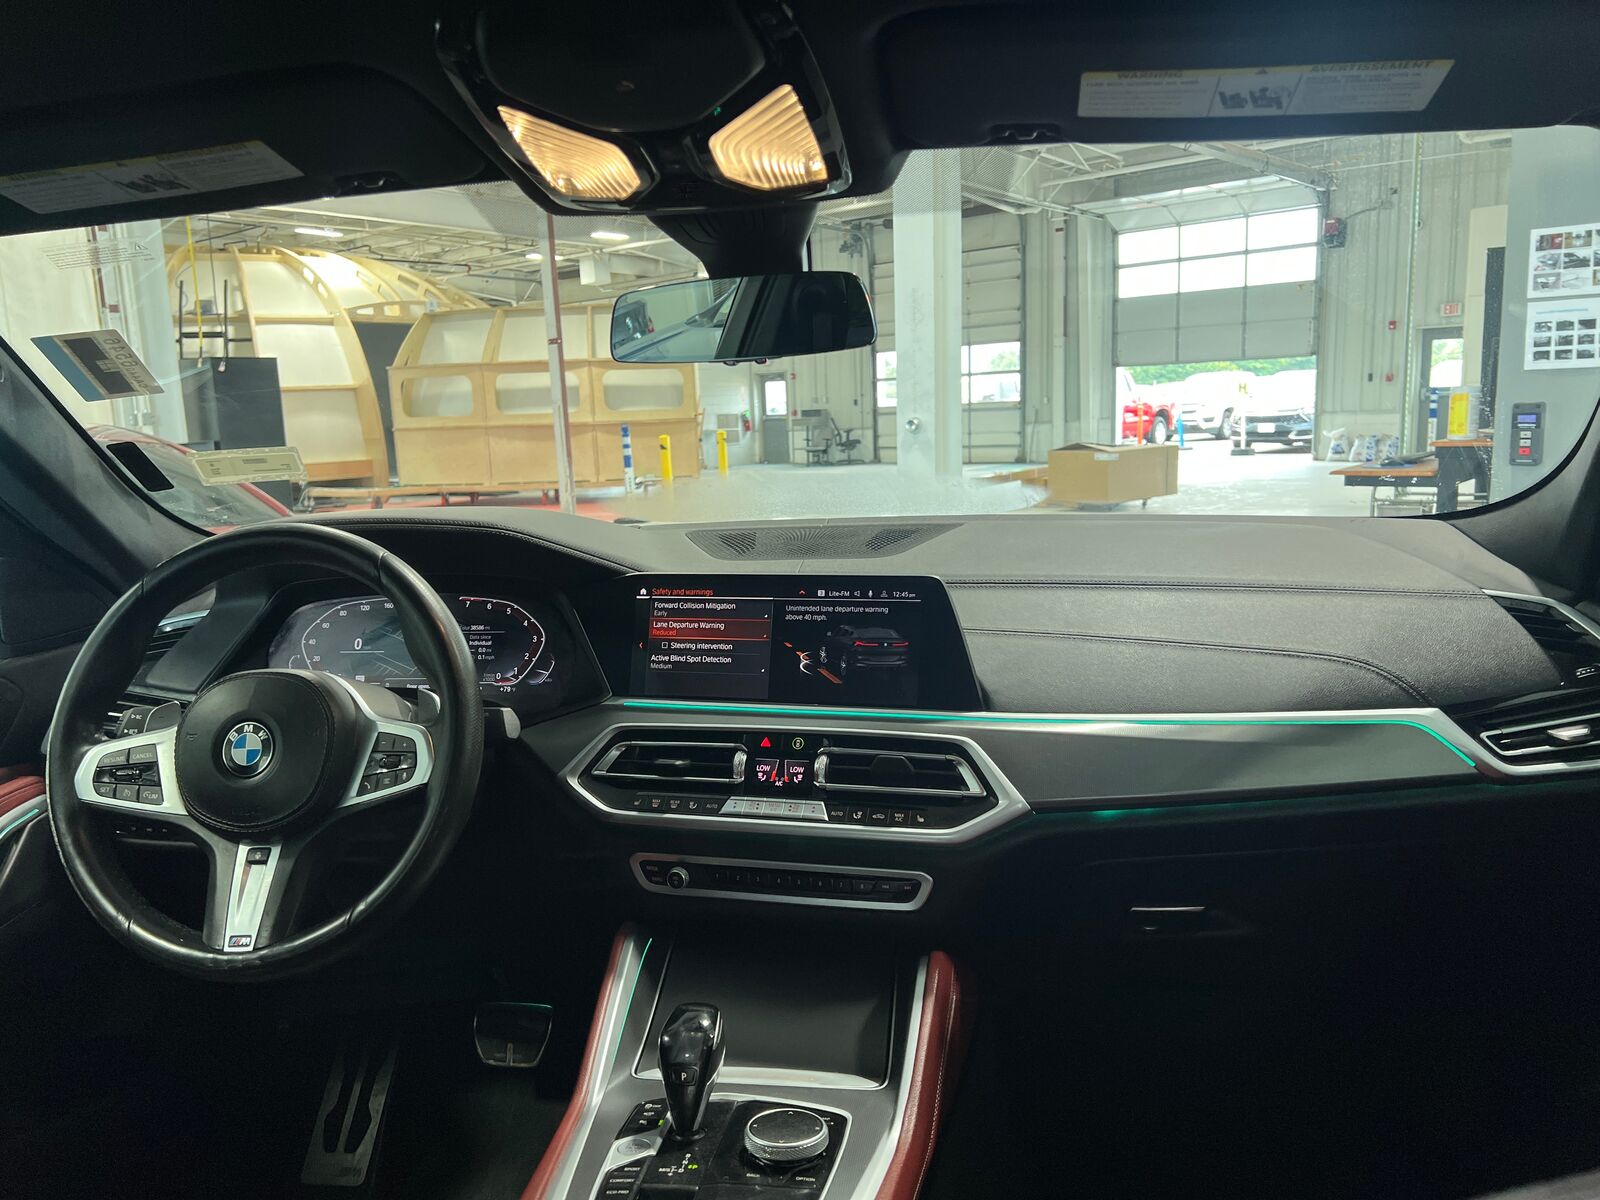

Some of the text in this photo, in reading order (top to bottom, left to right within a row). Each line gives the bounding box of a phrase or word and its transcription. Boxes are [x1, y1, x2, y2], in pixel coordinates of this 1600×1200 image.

[1117, 70, 1183, 80] WARNING
[651, 588, 671, 596] Safety
[705, 602, 736, 611] Mitigation
[834, 606, 864, 614] departure
[864, 606, 889, 614] warning
[700, 622, 725, 631] Warning
[354, 638, 362, 650] 0
[670, 642, 733, 650] Steering intervention
[650, 654, 669, 662] Active
[229, 724, 269, 742] BMW
[104, 756, 125, 764] RESUME
[681, 1073, 687, 1081] P
